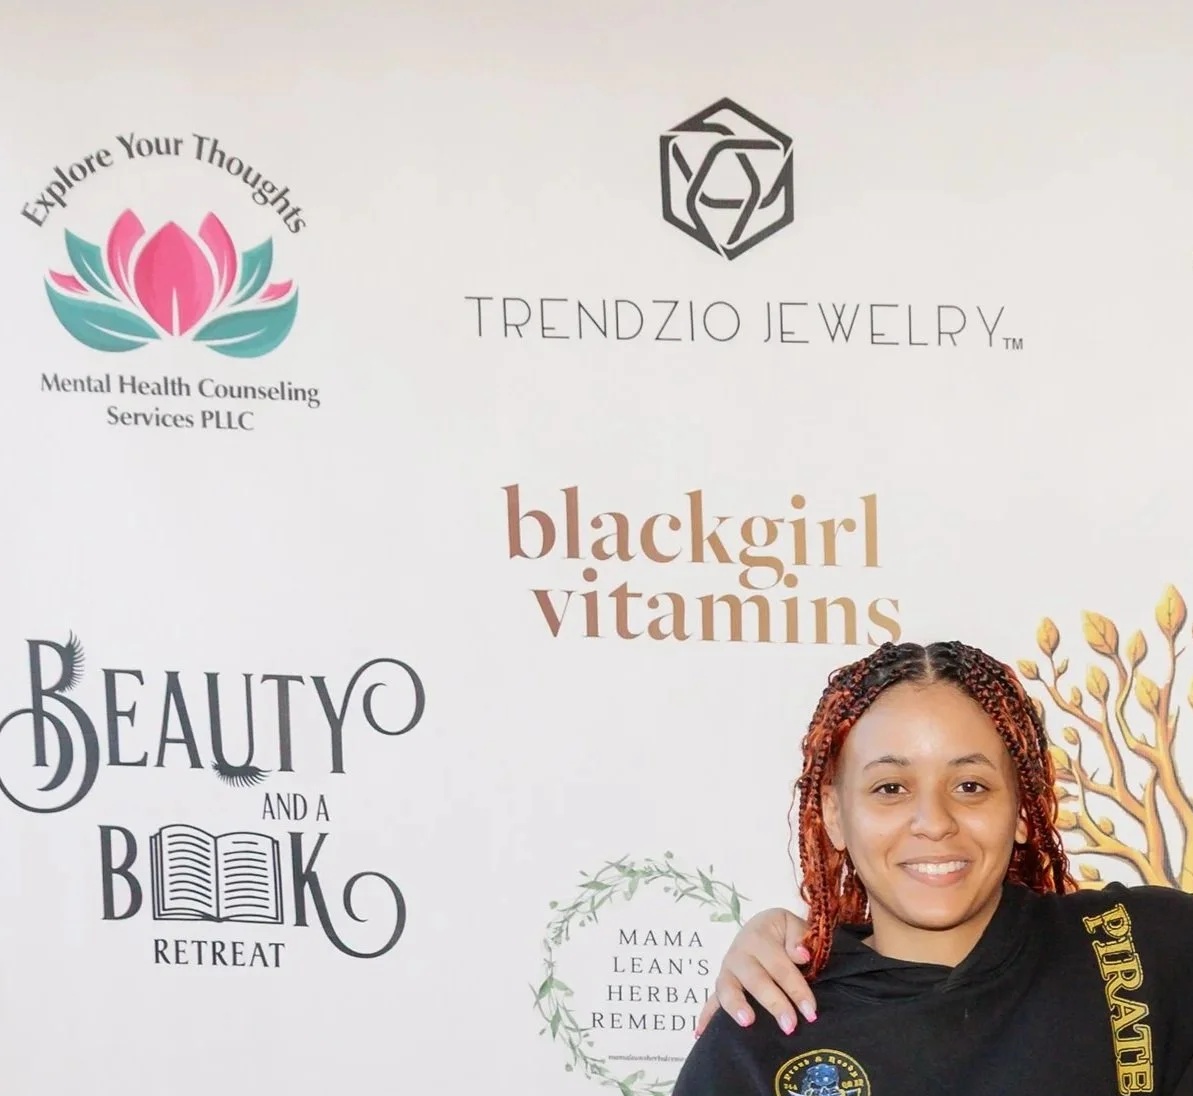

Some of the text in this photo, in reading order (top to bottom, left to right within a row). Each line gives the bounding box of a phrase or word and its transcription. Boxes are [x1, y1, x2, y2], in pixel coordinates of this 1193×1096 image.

[20, 132, 308, 235] Explore Your Thoughts
[464, 296, 741, 342] TRENDZIO
[763, 301, 1005, 348] JEWELRY
[40, 372, 321, 408] Mental Health Counseling
[106, 405, 255, 431] Services PLLC
[500, 483, 881, 591] blackgirl
[529, 567, 903, 647] vitamins
[0, 632, 426, 814] BEAUTY
[261, 793, 331, 822] AND A
[153, 939, 286, 968] RETREAT
[618, 928, 704, 948] MAMA
[613, 956, 710, 976] LEAN'S
[1083, 902, 1153, 1096] PIRATE
